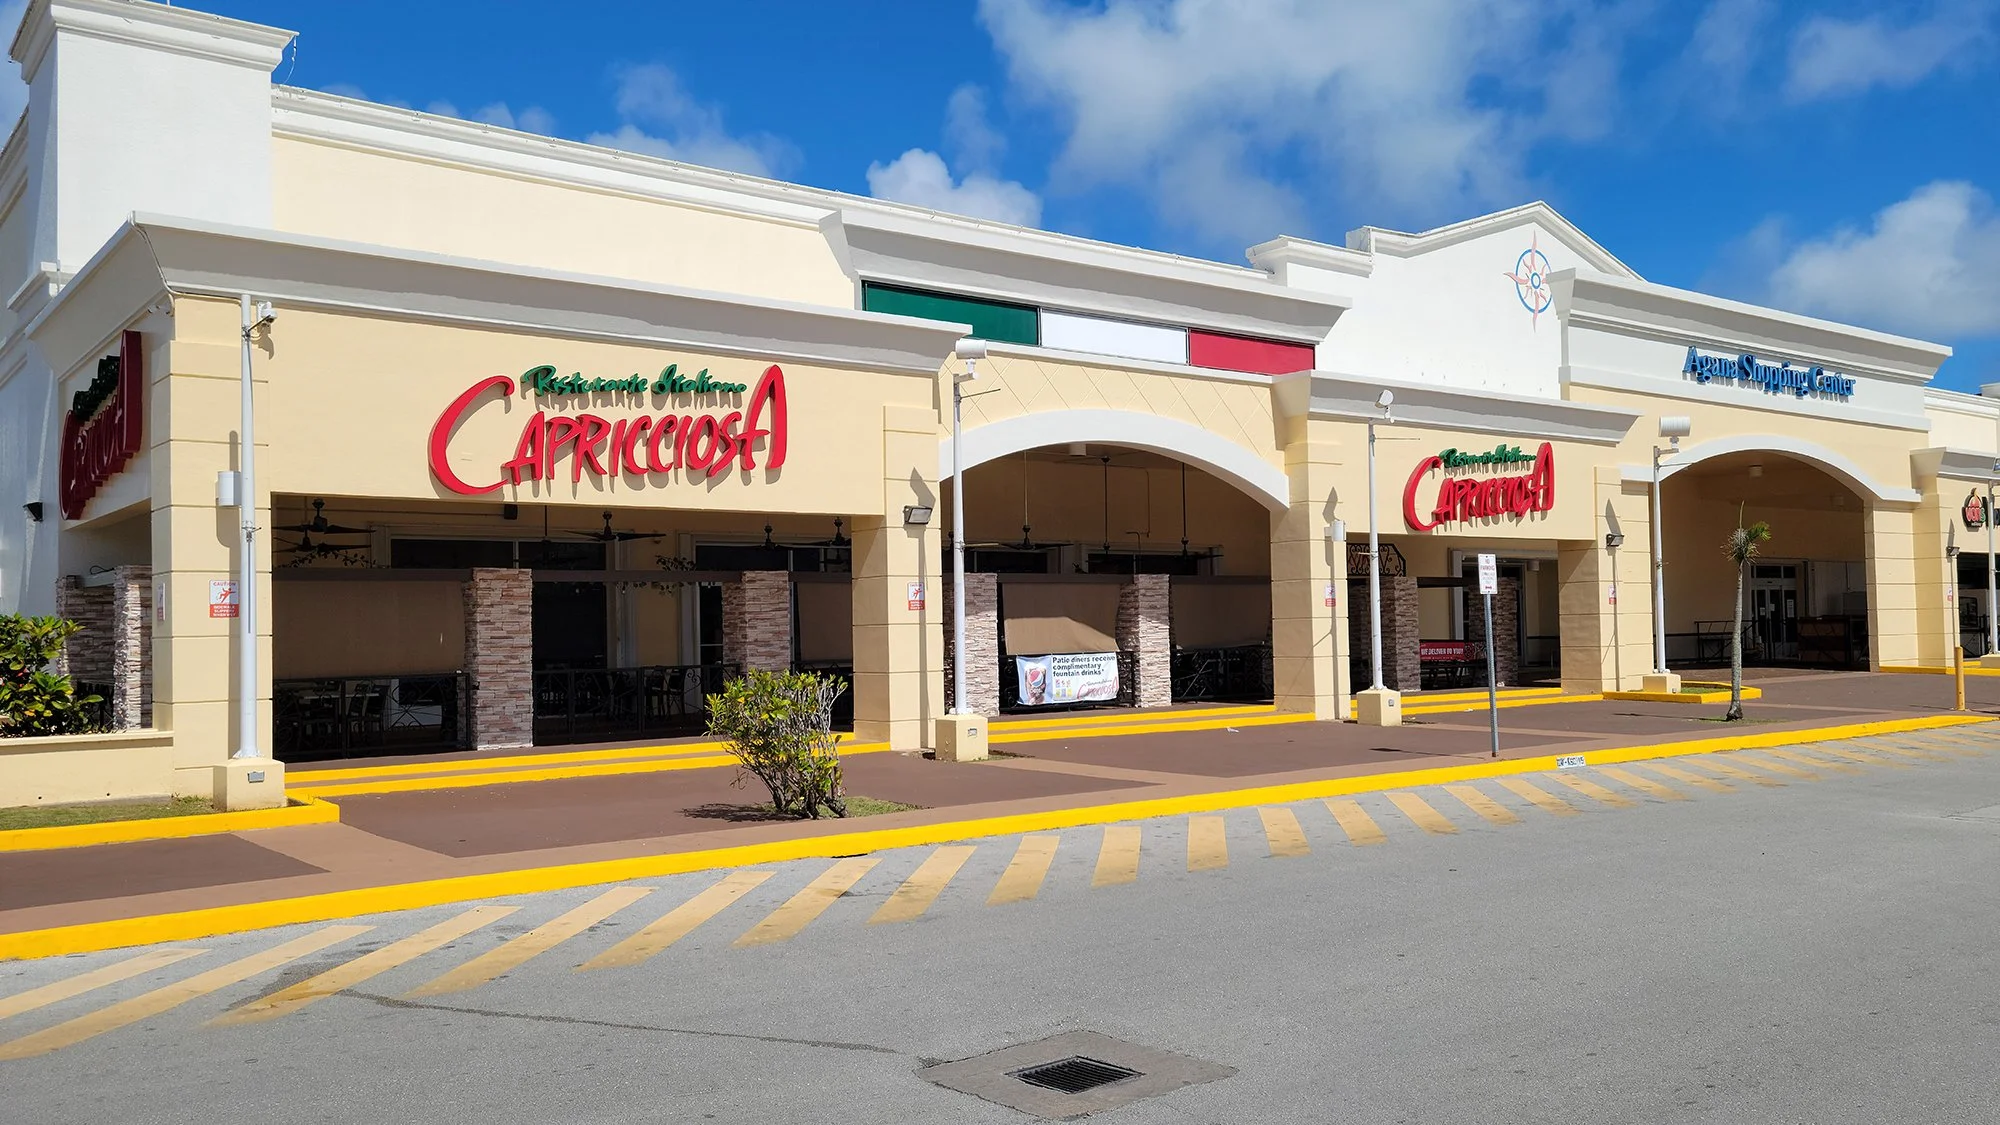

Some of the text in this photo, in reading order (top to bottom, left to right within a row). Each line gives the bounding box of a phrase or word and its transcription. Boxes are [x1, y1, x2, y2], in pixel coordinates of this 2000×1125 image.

[650, 363, 748, 396] Italiano
[1683, 346, 1857, 397] Agana Shopping Center
[428, 364, 788, 495] CAPRICCIOSA
